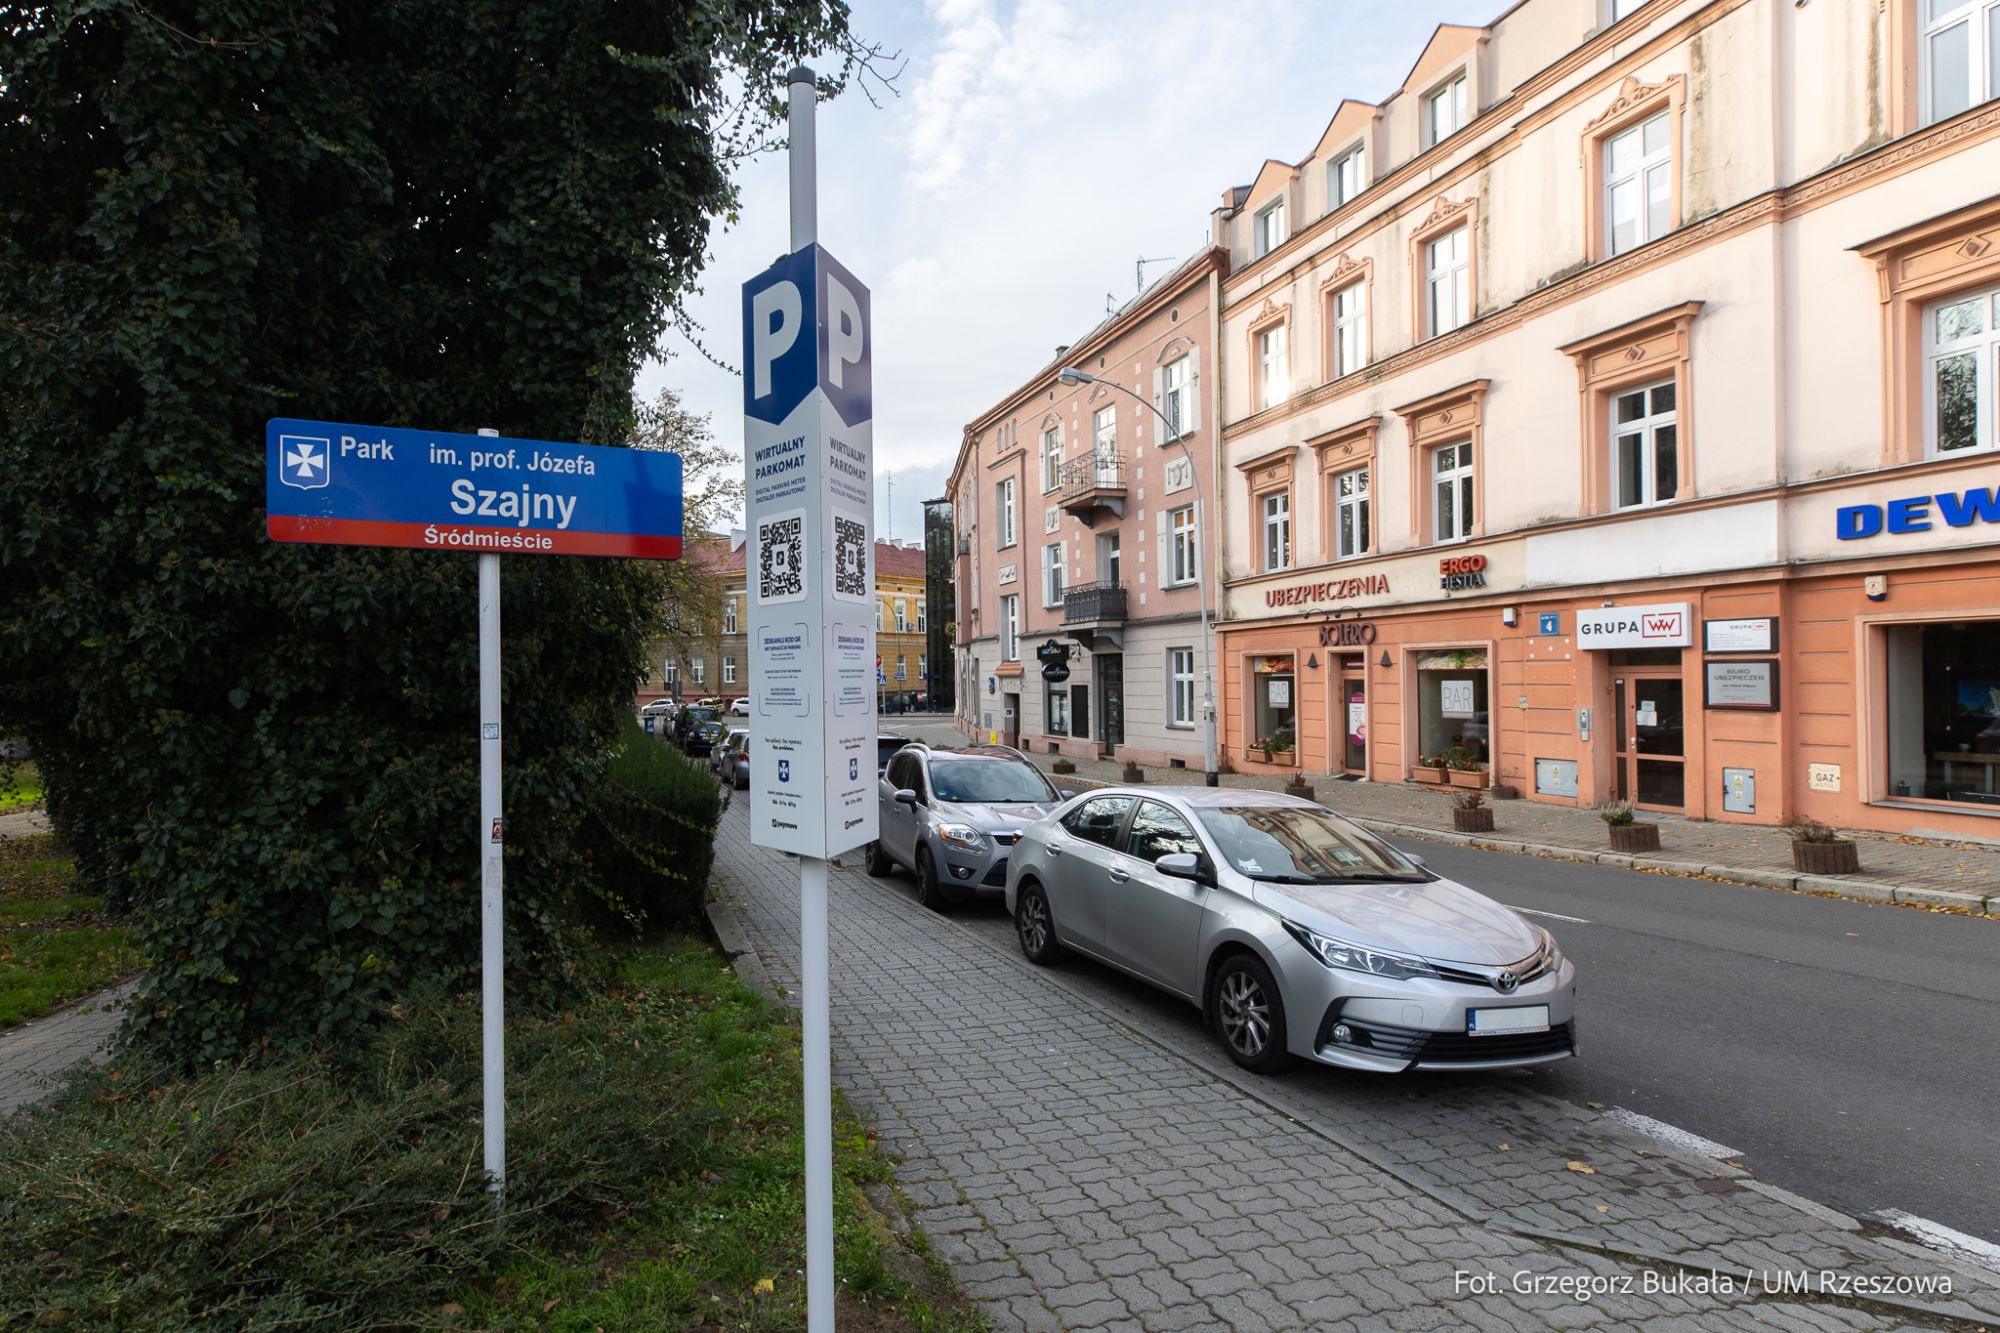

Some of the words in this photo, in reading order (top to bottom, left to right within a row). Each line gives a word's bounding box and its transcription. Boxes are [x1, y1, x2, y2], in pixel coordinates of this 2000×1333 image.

[753, 280, 802, 400] P
[827, 272, 864, 390] P
[340, 436, 394, 461] Park
[430, 444, 462, 466] im.
[471, 448, 520, 472] prof.
[527, 451, 595, 476] Józefa
[755, 435, 805, 462] WIRTUALNY
[830, 436, 866, 464] WIRTUALNY
[755, 454, 805, 480] PARKOMAT
[830, 455, 866, 481] PARKOMAT
[450, 479, 577, 530] Szajny
[424, 525, 553, 550] Śródmieście
[1440, 555, 1487, 575] ERGO
[1265, 574, 1390, 608] UBEZPIECZENIA
[1440, 572, 1487, 592] HESTIA
[1319, 621, 1377, 646] BOLERO
[1545, 620, 1553, 632] 4
[1581, 622, 1639, 635] GRUPA
[1270, 682, 1288, 704] BAR
[1443, 686, 1473, 711] BAR
[1816, 772, 1834, 782] GAZ
